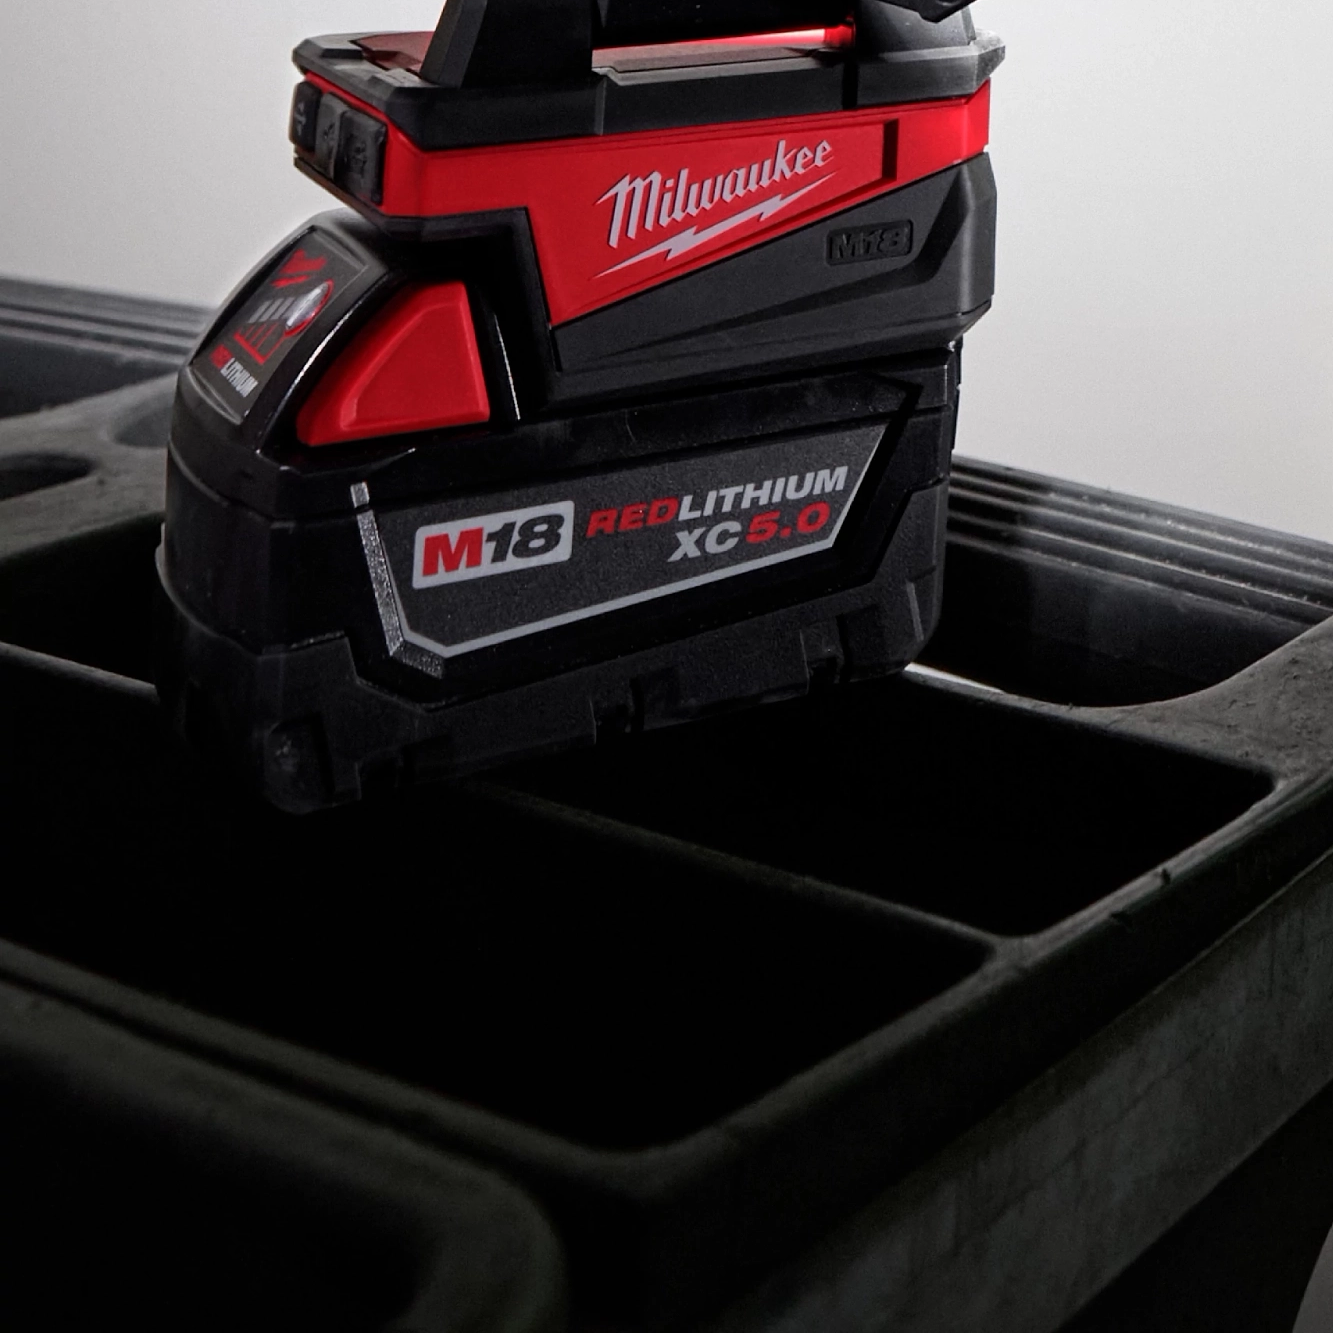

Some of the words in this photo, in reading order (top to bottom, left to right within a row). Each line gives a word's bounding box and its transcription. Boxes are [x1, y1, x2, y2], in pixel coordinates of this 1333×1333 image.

[593, 139, 835, 249] Milwaukee
[828, 226, 910, 261] M18
[586, 465, 848, 538] REDLITHIUM
[421, 514, 565, 577] M18
